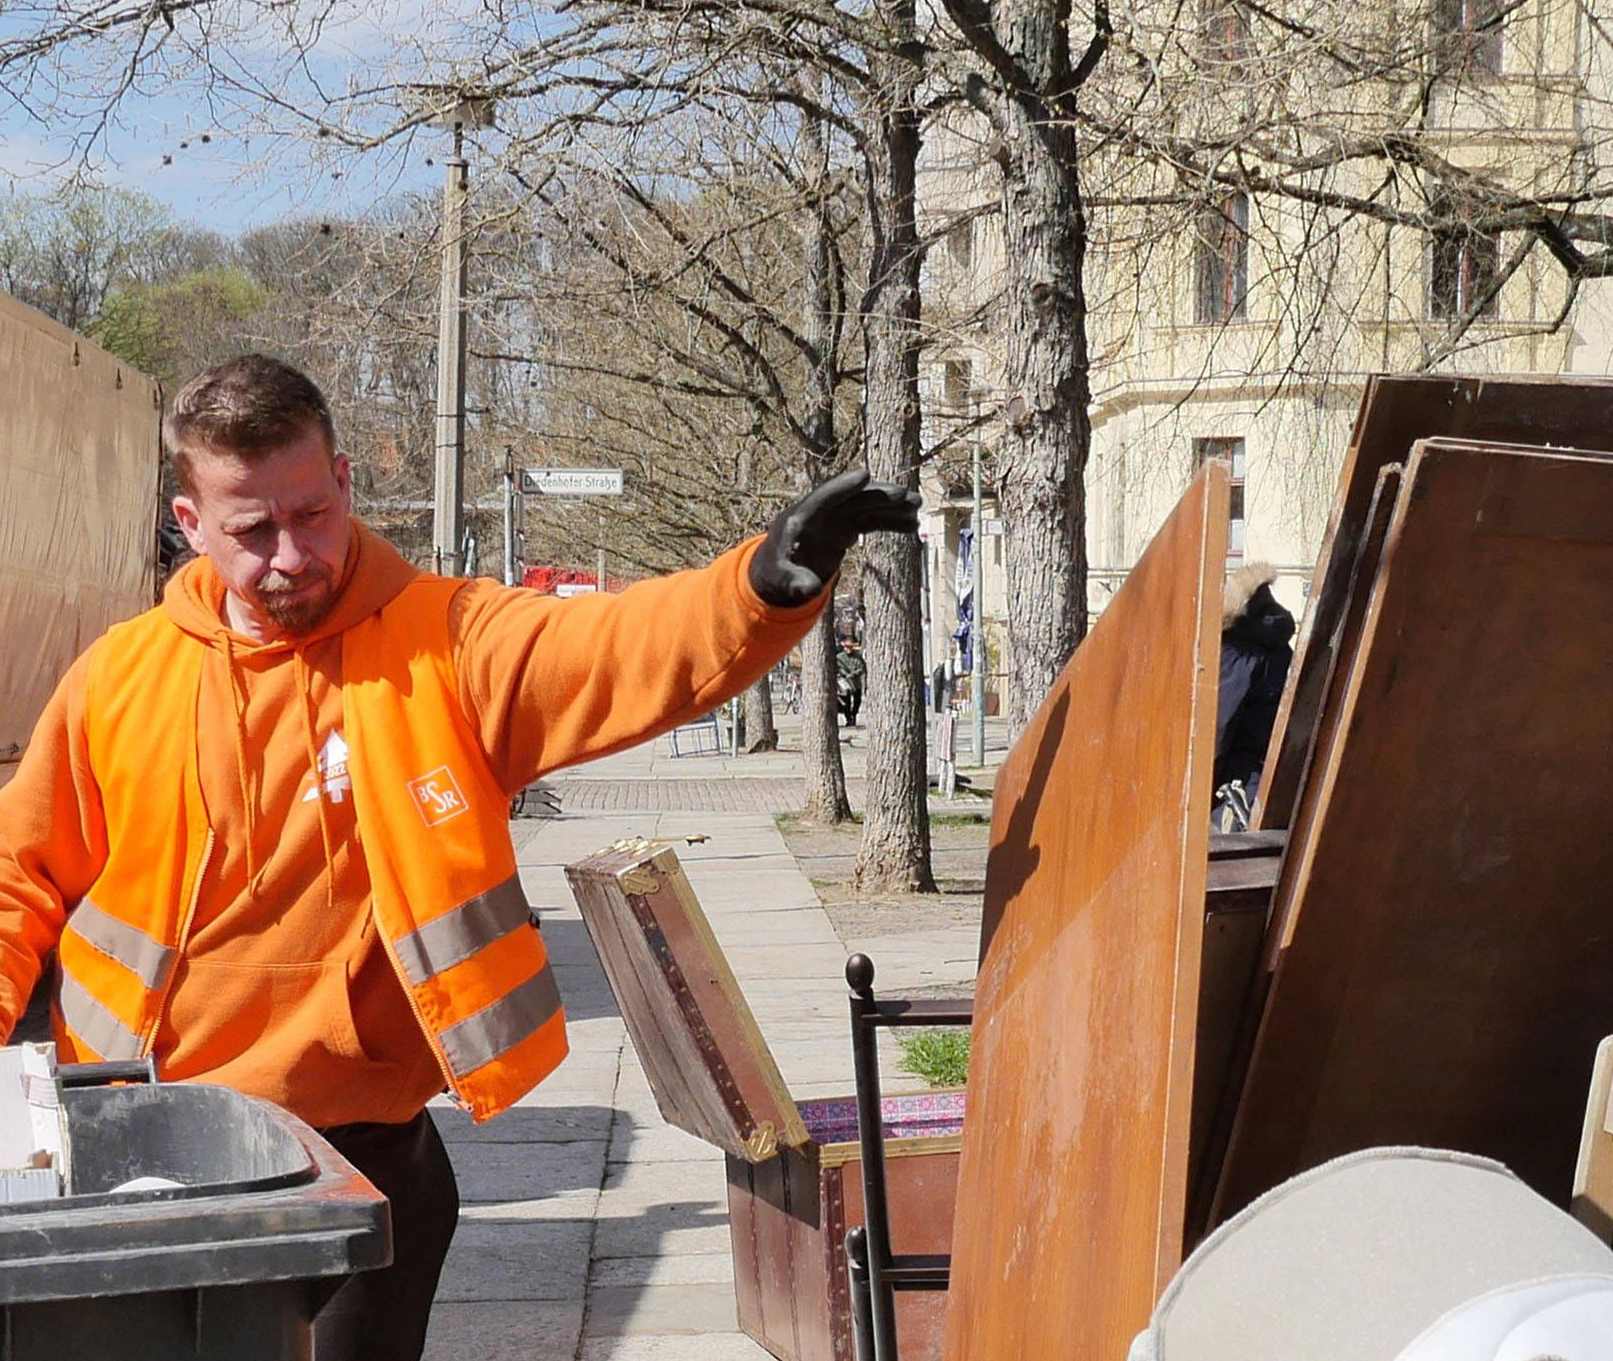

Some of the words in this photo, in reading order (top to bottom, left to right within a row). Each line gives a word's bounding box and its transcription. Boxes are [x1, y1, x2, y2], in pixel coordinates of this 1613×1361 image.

[524, 475, 583, 488] Diedenhofer
[585, 475, 617, 490] Straße
[416, 780, 459, 813] BSR
